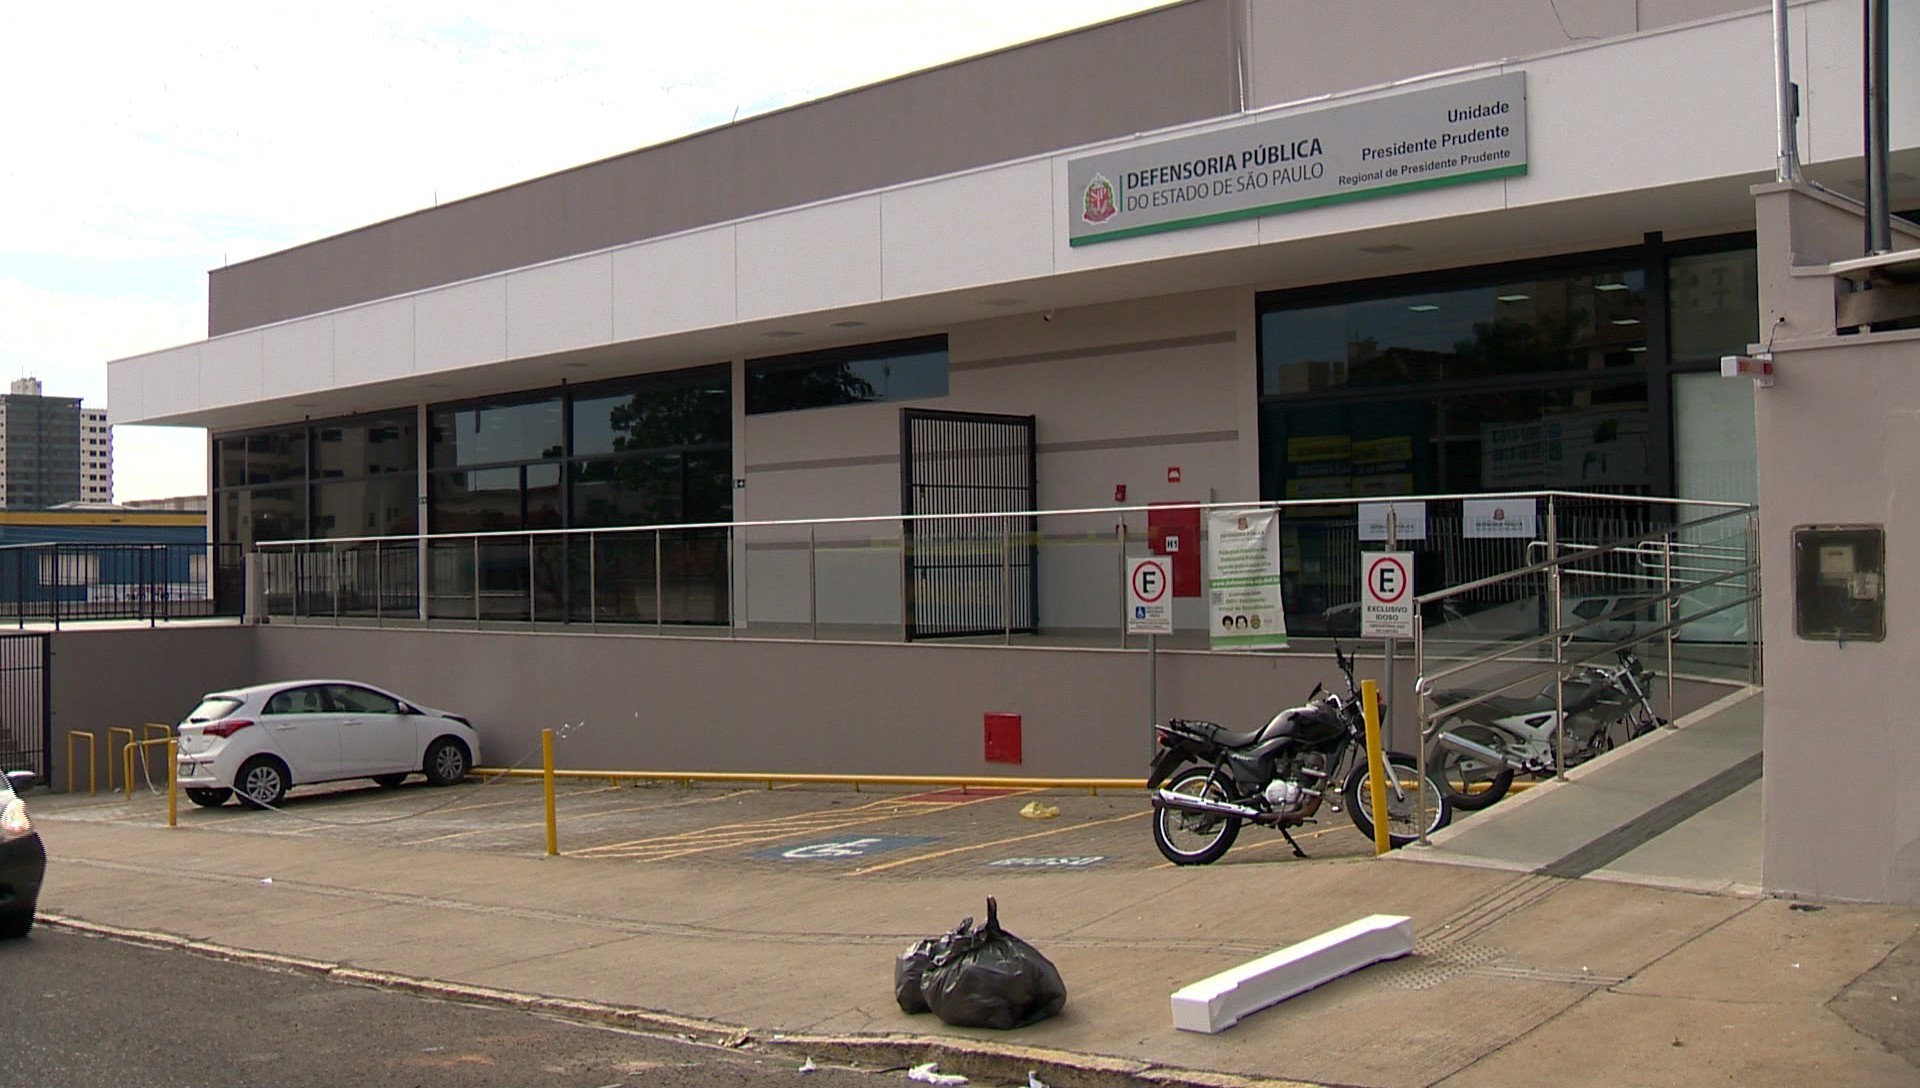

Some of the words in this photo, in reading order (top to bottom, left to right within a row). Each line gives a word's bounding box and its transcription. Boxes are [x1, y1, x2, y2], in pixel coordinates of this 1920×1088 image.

[1448, 101, 1509, 123] Unidade
[1362, 138, 1437, 161] Presidente
[1441, 125, 1509, 148] Prudente
[1127, 154, 1237, 190] DEFENSORIA
[1242, 138, 1323, 169] PÚBLICA
[1338, 169, 1383, 186] Regional
[1385, 167, 1398, 178] de
[1401, 158, 1457, 176] Presidente
[1460, 149, 1511, 166] Prudente
[1127, 194, 1149, 212] DO
[1152, 183, 1209, 208] ESTADO
[1213, 179, 1233, 196] DE
[1237, 171, 1268, 193] SÃO
[1272, 162, 1324, 186] PAULO
[1380, 568, 1394, 593] E
[1367, 605, 1407, 613] EXCLUSIVO
